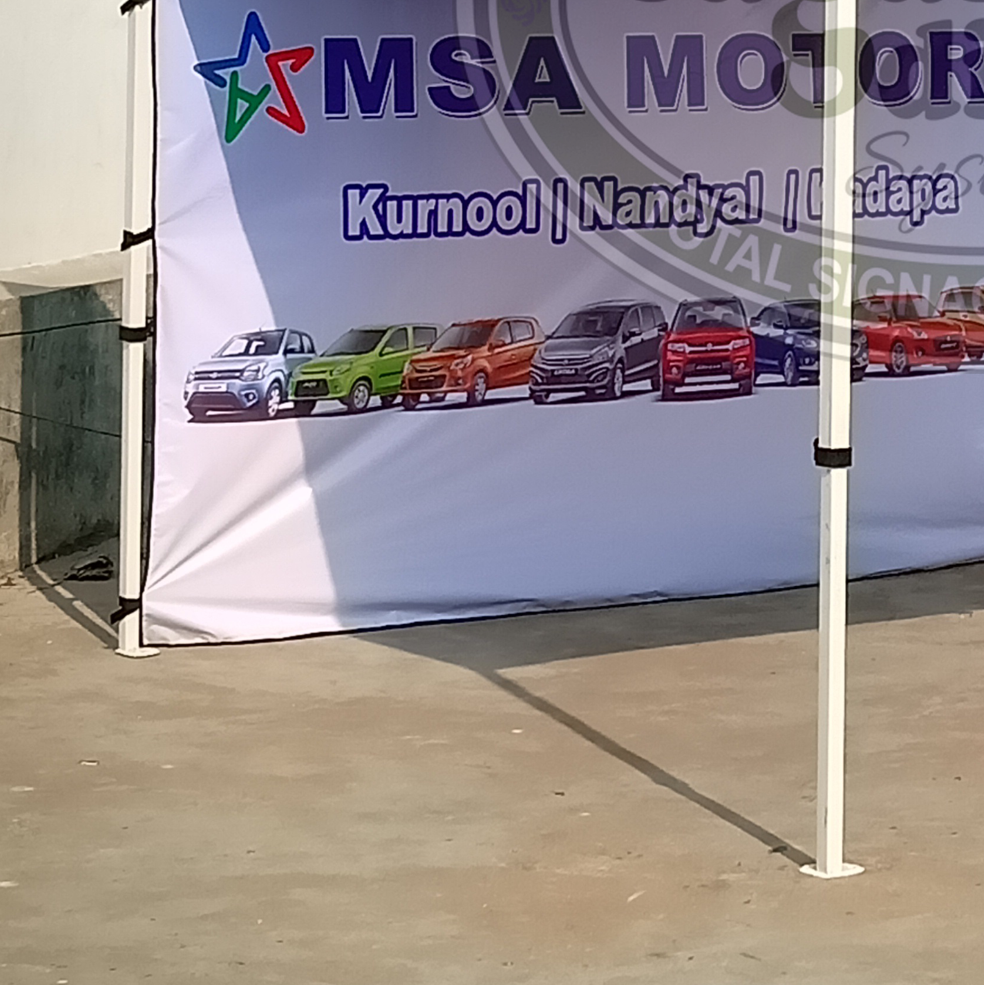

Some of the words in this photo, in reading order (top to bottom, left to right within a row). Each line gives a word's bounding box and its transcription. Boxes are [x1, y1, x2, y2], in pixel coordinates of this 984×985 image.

[322, 34, 586, 120] MSA
[343, 178, 538, 242] Kurnool
[579, 169, 763, 237] Nandyal
